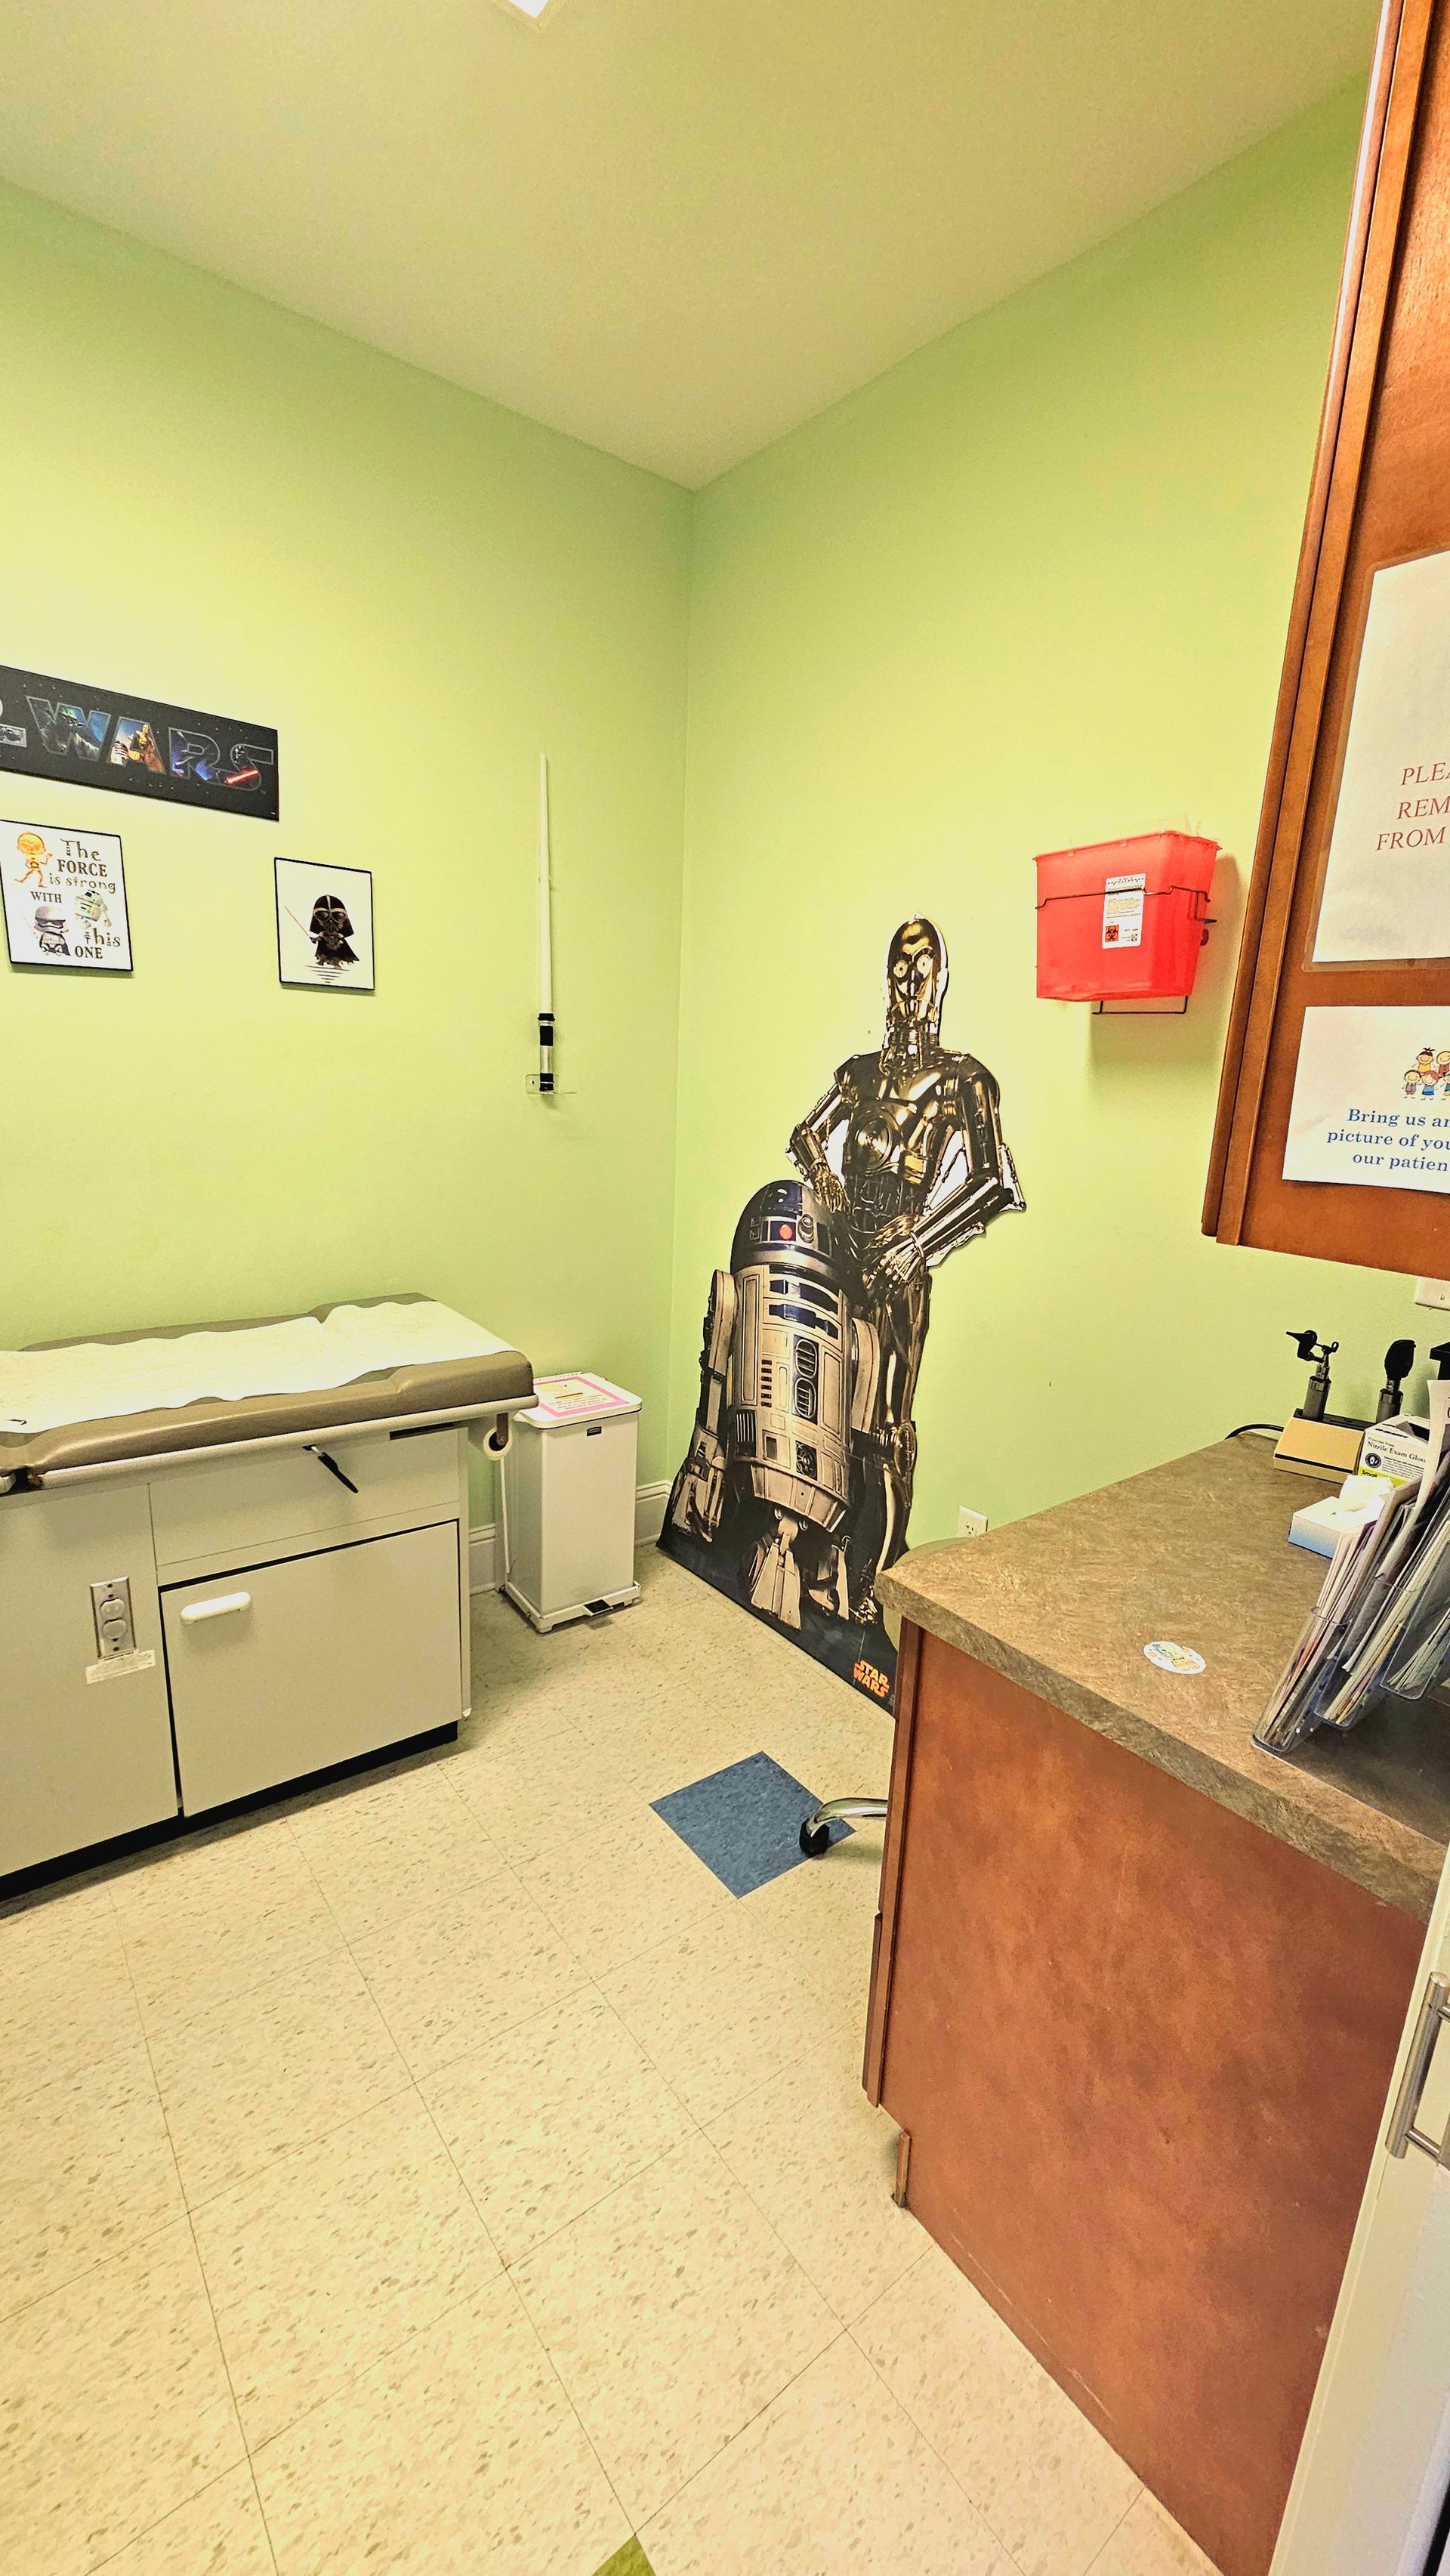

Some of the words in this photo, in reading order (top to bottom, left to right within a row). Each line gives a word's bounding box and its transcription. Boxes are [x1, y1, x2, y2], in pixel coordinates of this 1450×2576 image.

[25, 695, 274, 791] WARS
[1401, 761, 1450, 786] PLE
[1396, 795, 1450, 820] REM
[1375, 826, 1447, 851] FROM
[60, 838, 101, 861] The
[57, 859, 108, 877] FORCE
[49, 873, 61, 885] is
[66, 876, 116, 894] strong
[30, 891, 62, 903] WITH
[84, 928, 121, 947] this
[75, 946, 103, 959] ONE
[1347, 1108, 1400, 1127] Bring
[1405, 1115, 1426, 1126] us
[1326, 1129, 1393, 1145] picture
[1399, 1134, 1420, 1147] of
[1353, 1154, 1384, 1166] our
[1389, 1157, 1448, 1172] patien
[1367, 1441, 1388, 1452] Nitrile
[1390, 1448, 1407, 1457] Exam
[853, 1666, 889, 1697] WARS
[854, 1660, 890, 1690] STAR
